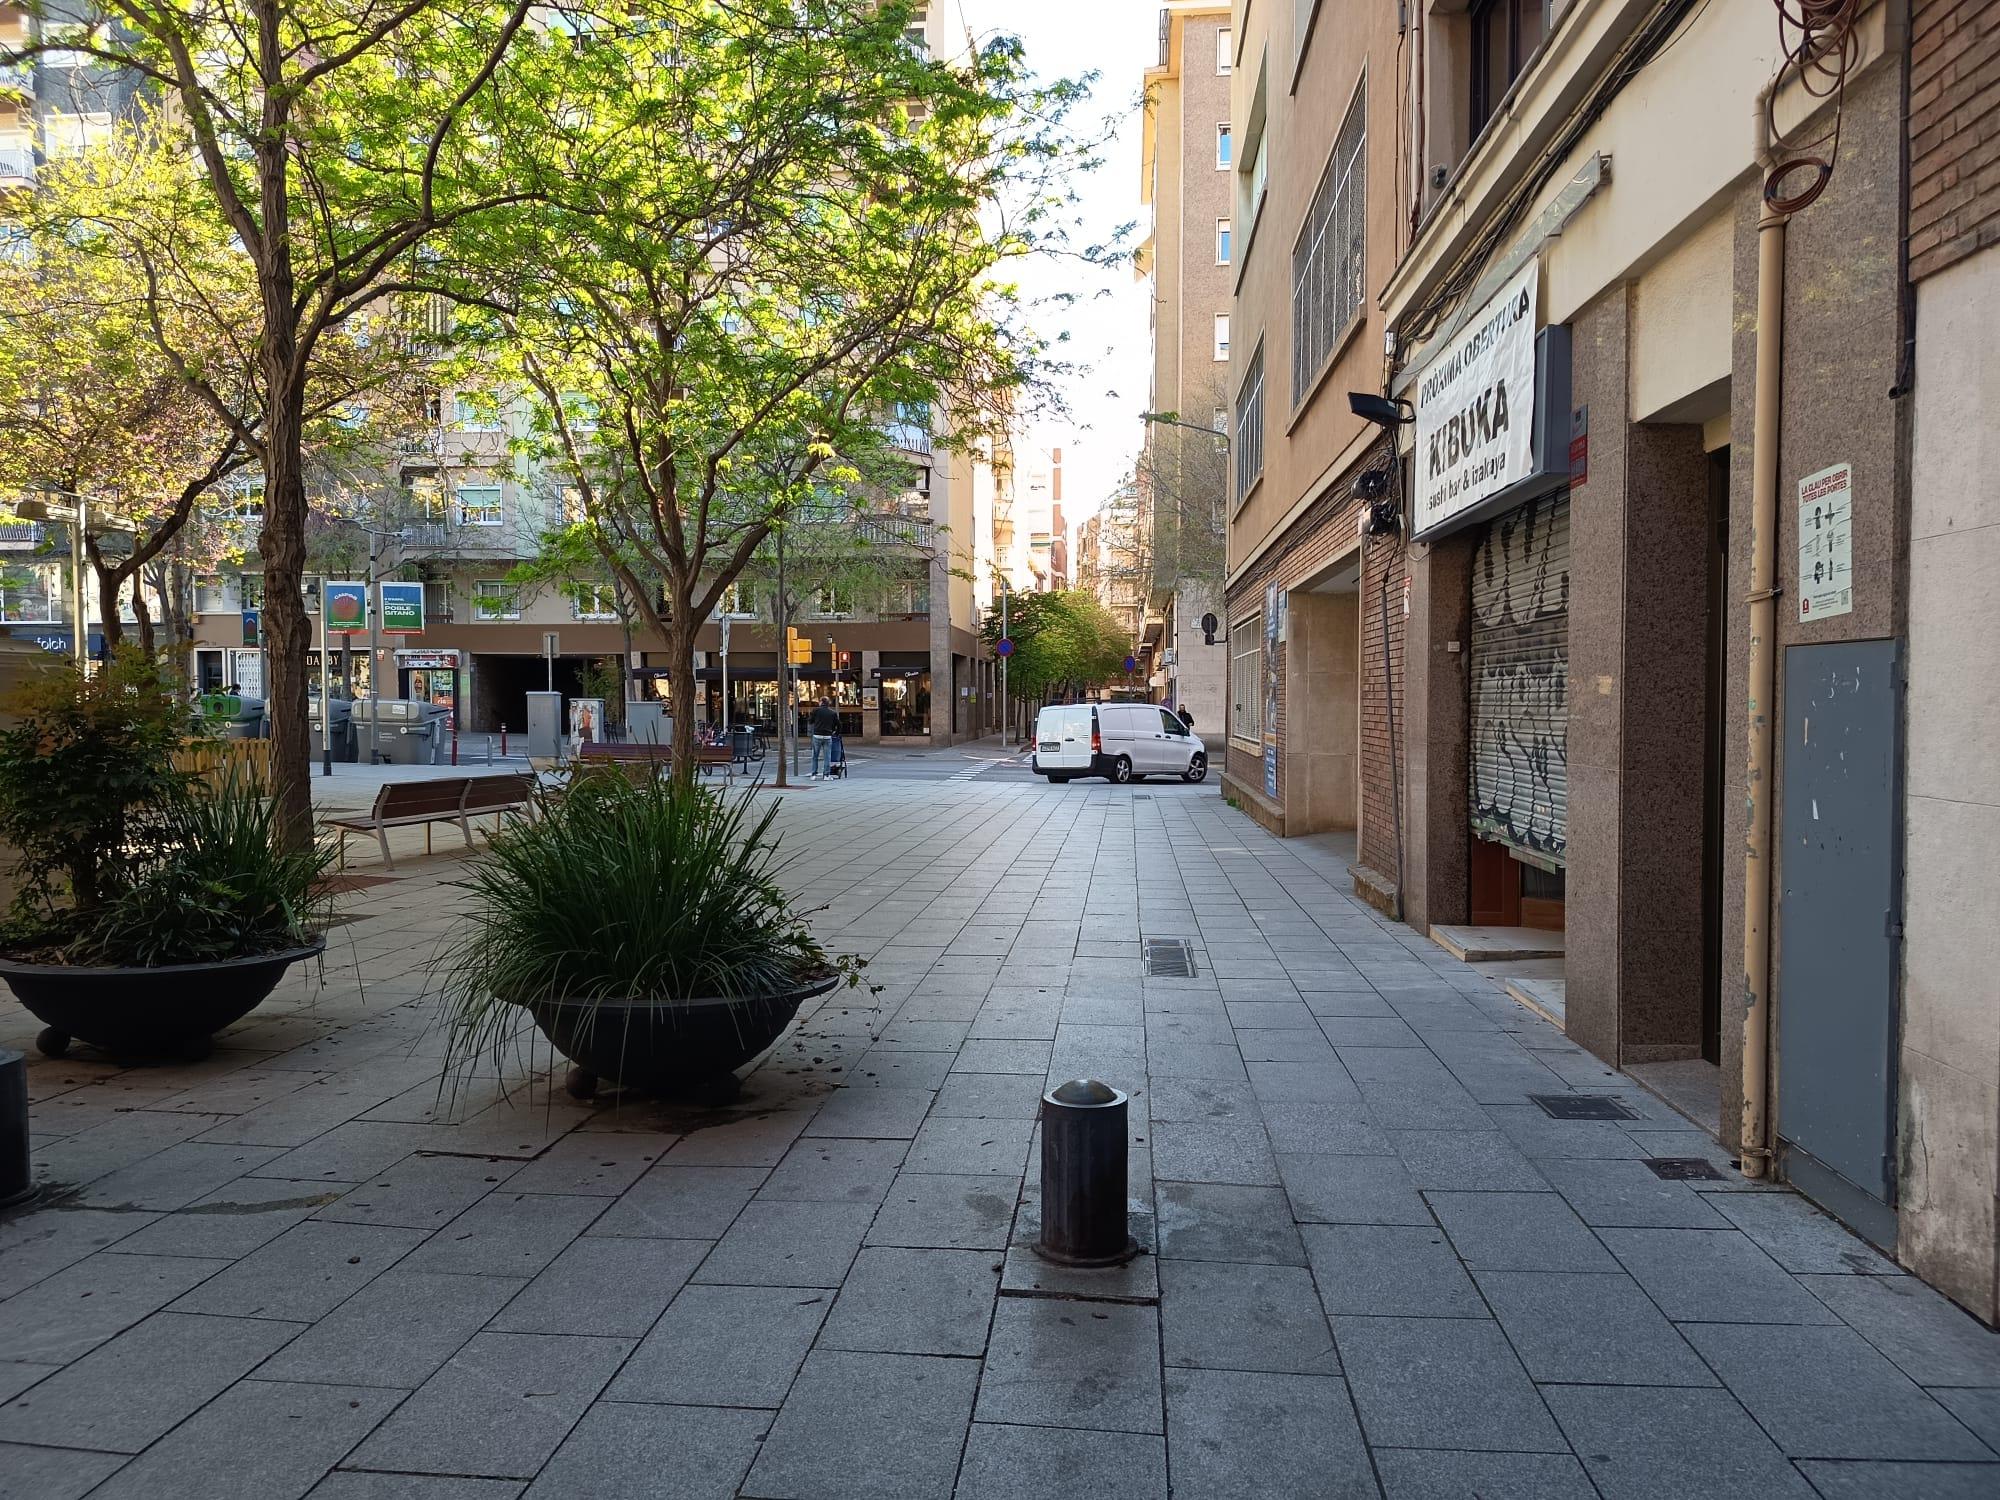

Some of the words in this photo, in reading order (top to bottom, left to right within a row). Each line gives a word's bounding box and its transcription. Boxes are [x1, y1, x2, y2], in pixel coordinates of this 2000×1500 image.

[1464, 286, 1530, 368] OBERTURA
[1429, 378, 1509, 480] KIBUKA
[1428, 484, 1447, 511] sushi
[1448, 477, 1461, 499] bar
[1463, 468, 1470, 491] &
[1472, 452, 1506, 487] izakaya
[1818, 487, 1827, 498] LES
[306, 655, 339, 666] DABY
